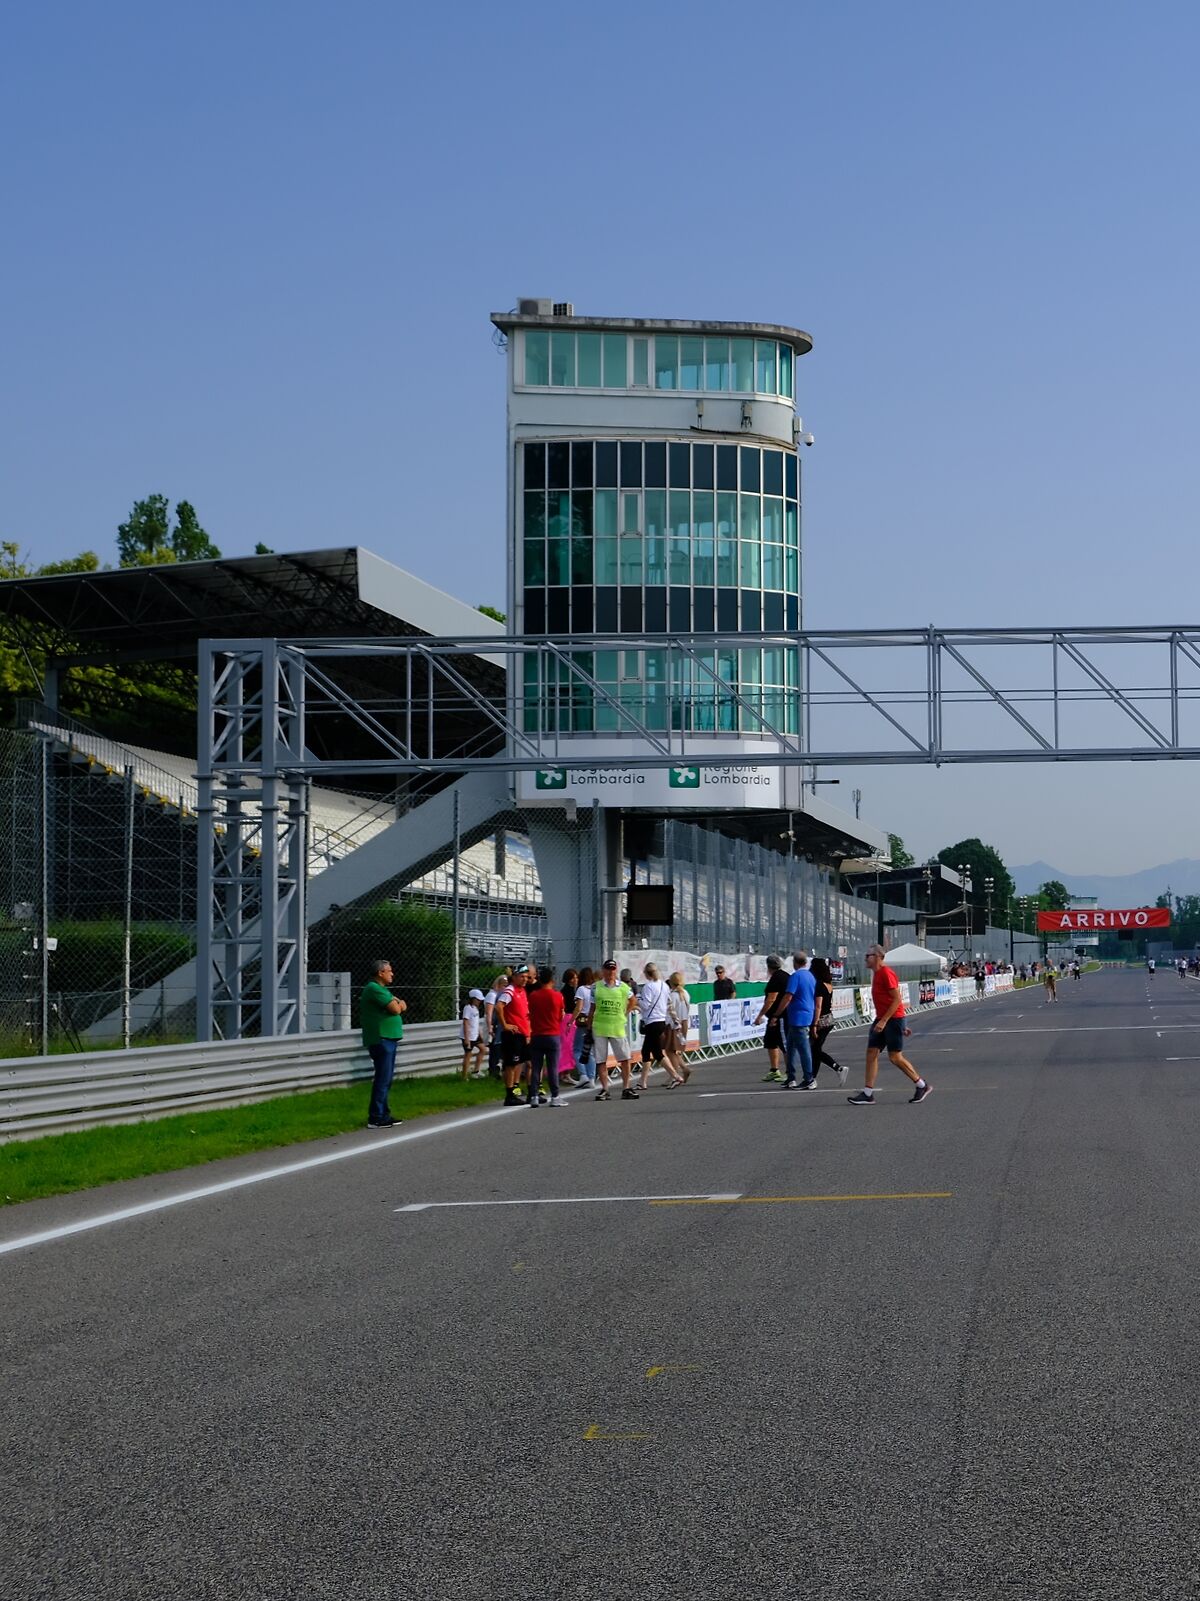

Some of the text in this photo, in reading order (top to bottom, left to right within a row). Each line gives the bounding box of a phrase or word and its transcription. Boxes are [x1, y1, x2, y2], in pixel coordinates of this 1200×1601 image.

[571, 774, 645, 785] Lombardia
[704, 774, 770, 785] Lombardia
[1060, 911, 1149, 927] ARRIVO
